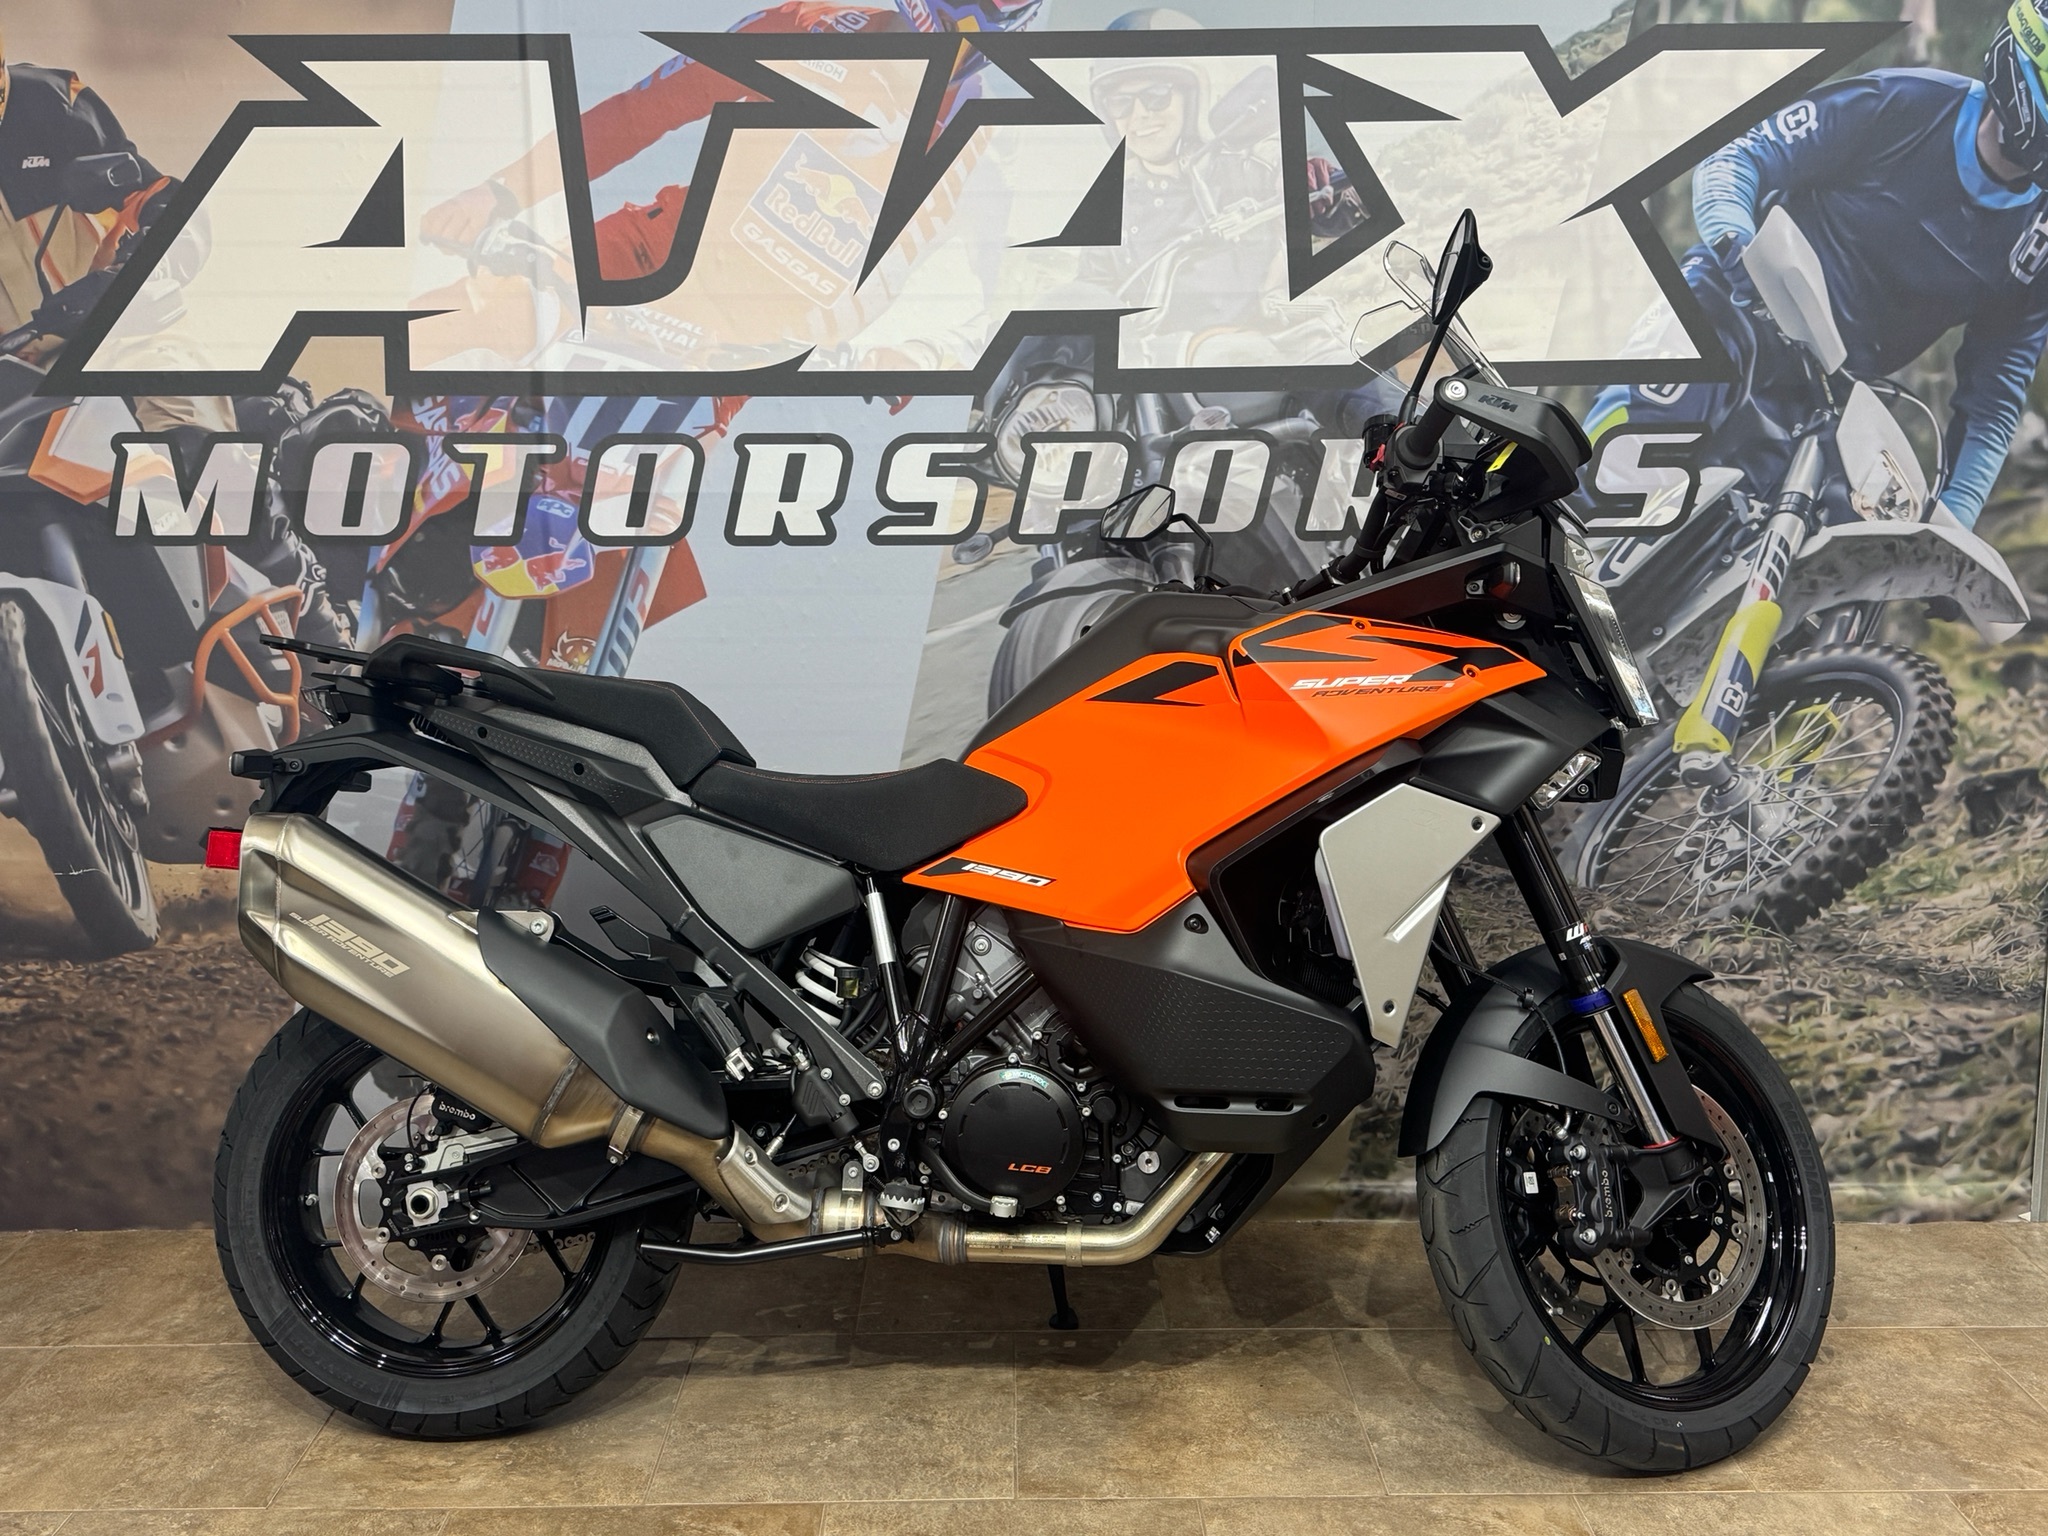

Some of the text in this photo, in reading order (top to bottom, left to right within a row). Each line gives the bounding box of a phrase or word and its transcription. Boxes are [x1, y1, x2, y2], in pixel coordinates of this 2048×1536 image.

[22, 156, 50, 169] KTM
[38, 23, 1907, 396] AJAX
[743, 222, 836, 295] GASGAS
[1478, 394, 1518, 413] KTM
[112, 433, 1702, 545] MOTORSPORS
[1289, 674, 1413, 690] SUPER
[1311, 685, 1443, 698] ADVENTURE
[961, 863, 1052, 887] 1390
[289, 912, 395, 978] SUPER ADVENTURE
[308, 914, 411, 975] 1390
[438, 1101, 476, 1121] brembo
[1008, 1163, 1053, 1175] LC8
[1601, 1170, 1614, 1218] brembo
